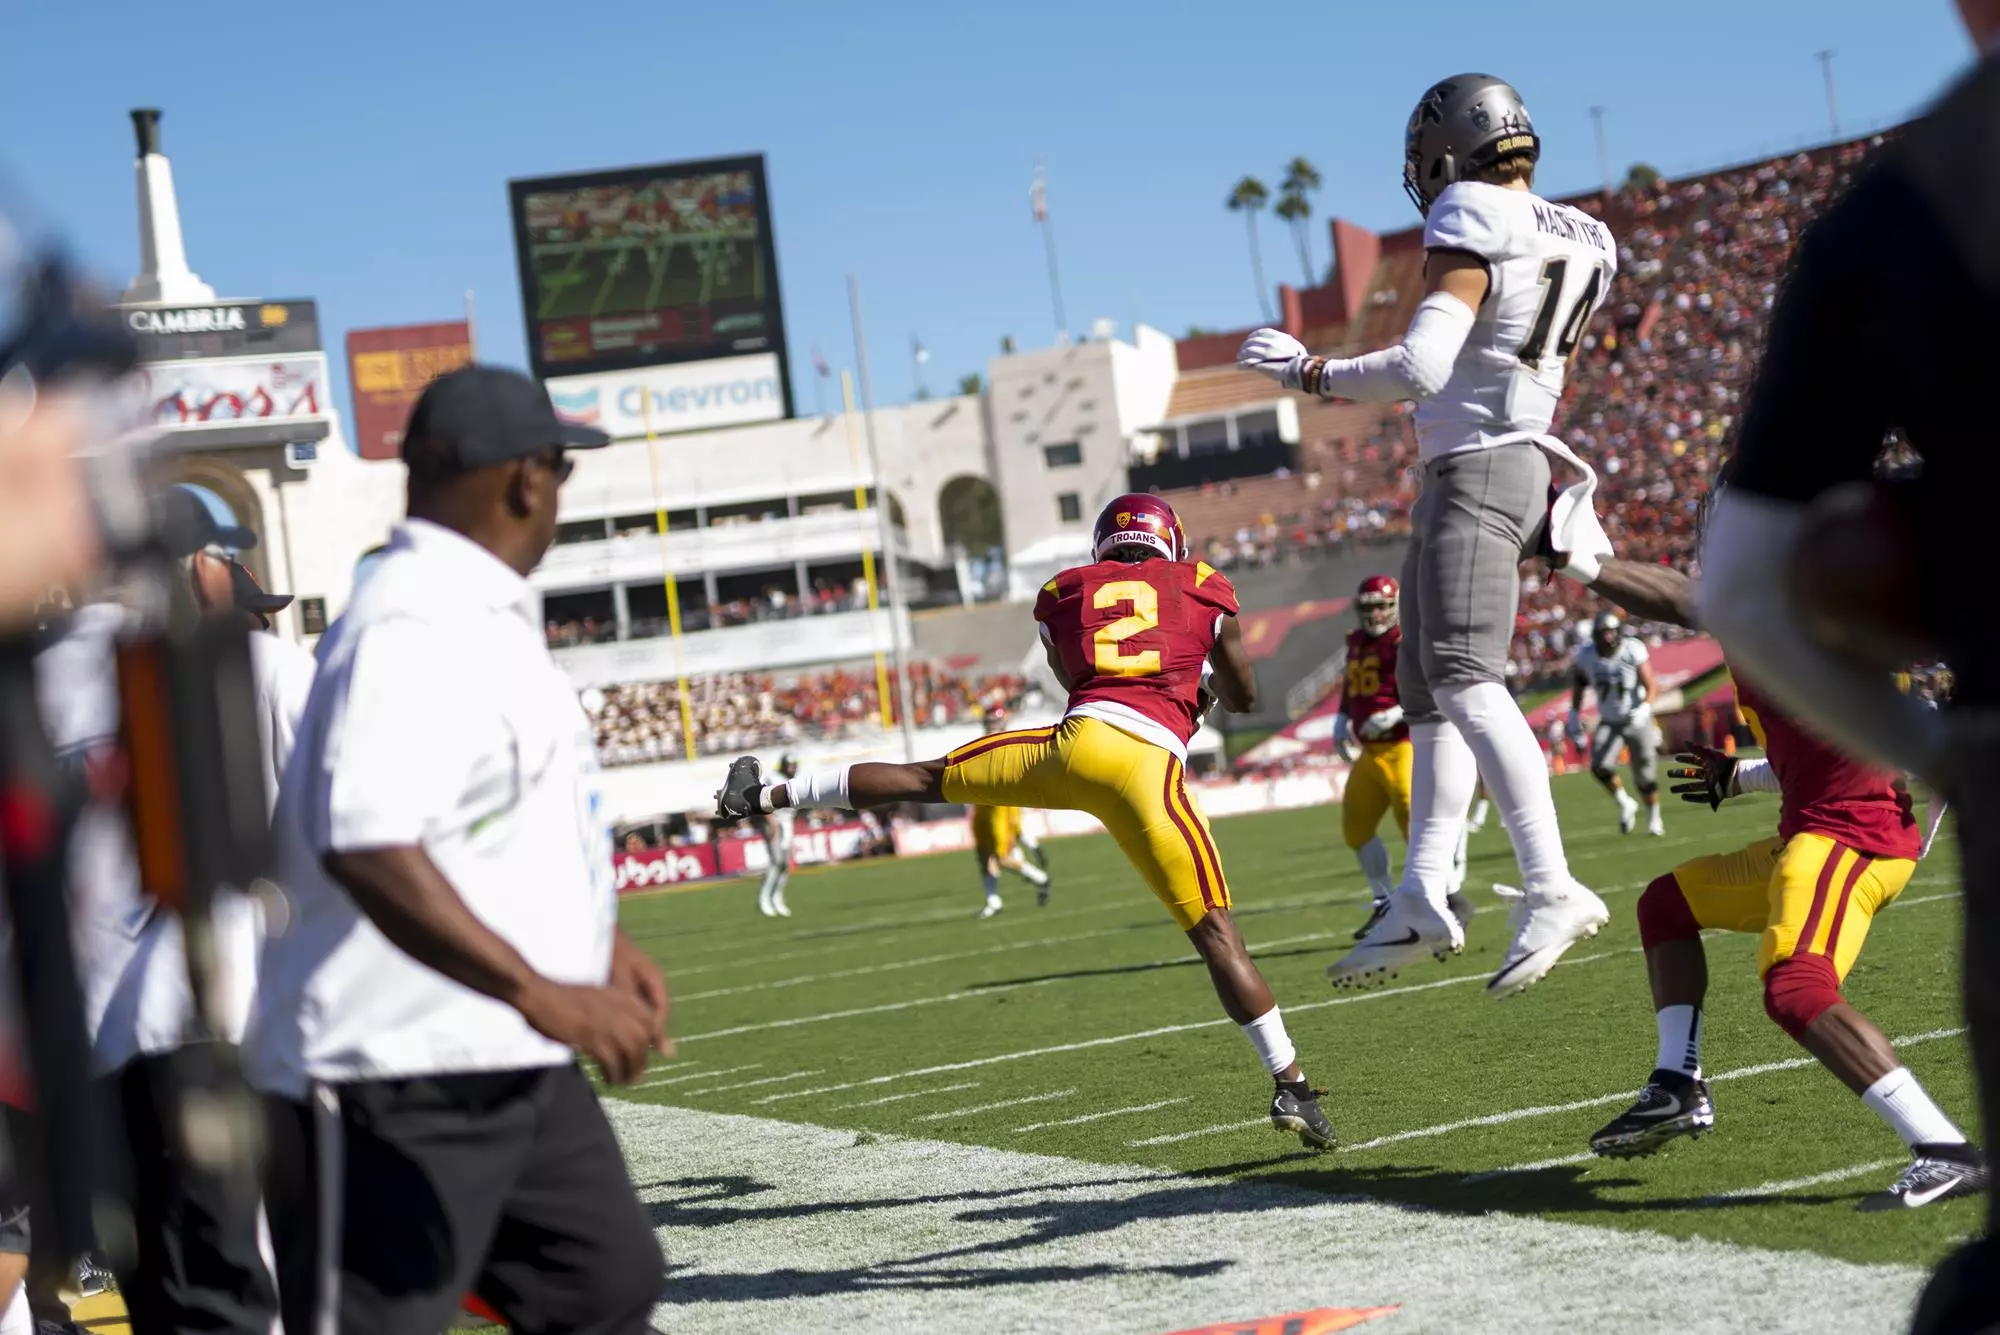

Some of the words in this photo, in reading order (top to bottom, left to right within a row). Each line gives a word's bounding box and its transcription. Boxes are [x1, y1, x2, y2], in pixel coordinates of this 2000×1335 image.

[1496, 135, 1534, 153] COLORADO
[1532, 203, 1606, 250] MACINTYRE
[129, 307, 246, 334] CAMBRIA
[1515, 253, 1604, 375] 14
[1111, 532, 1156, 545] TROJANS
[1093, 580, 1161, 677] 2
